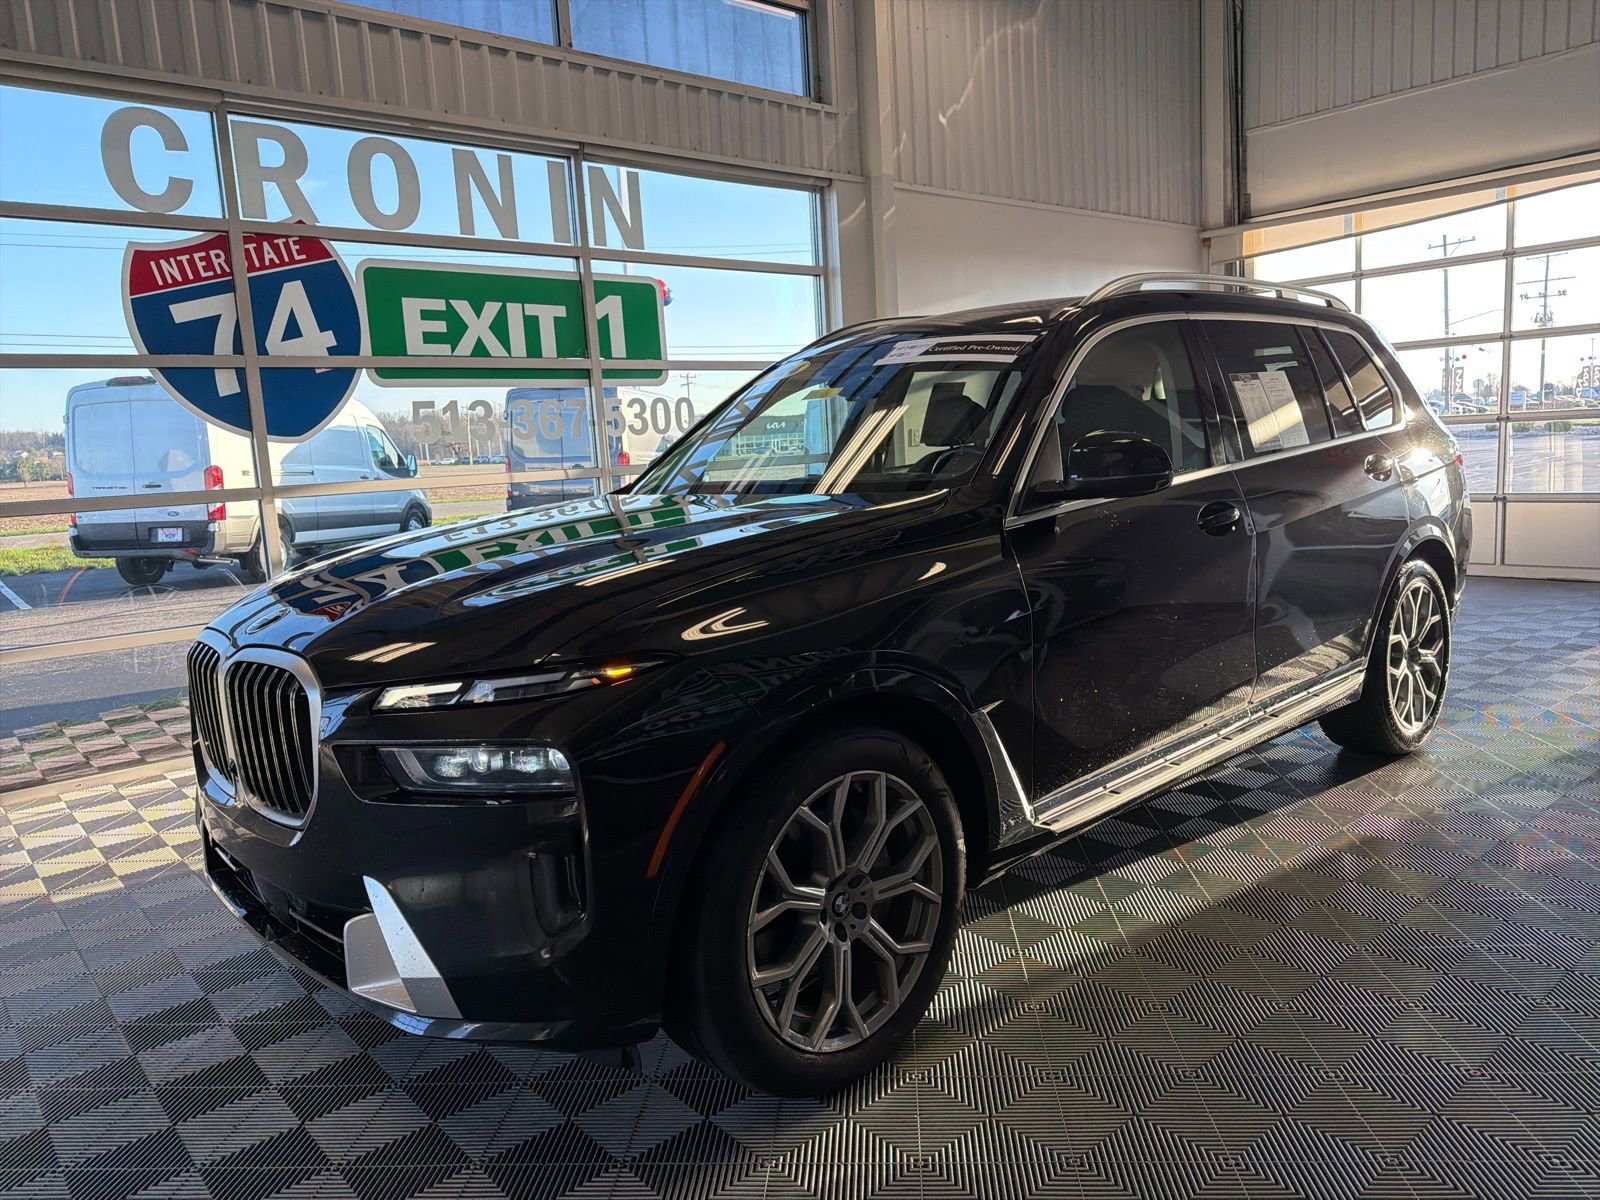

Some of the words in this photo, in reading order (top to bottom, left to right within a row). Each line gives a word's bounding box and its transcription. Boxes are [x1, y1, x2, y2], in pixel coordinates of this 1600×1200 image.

[100, 107, 646, 251] CRONIN
[149, 236, 308, 287] INTERTATE
[168, 279, 338, 398] 74
[401, 297, 568, 359] EXIT
[594, 295, 628, 359] 1
[928, 343, 967, 352] Certified
[968, 343, 1021, 352] Pre-Owned
[411, 396, 696, 445] 513-3675300
